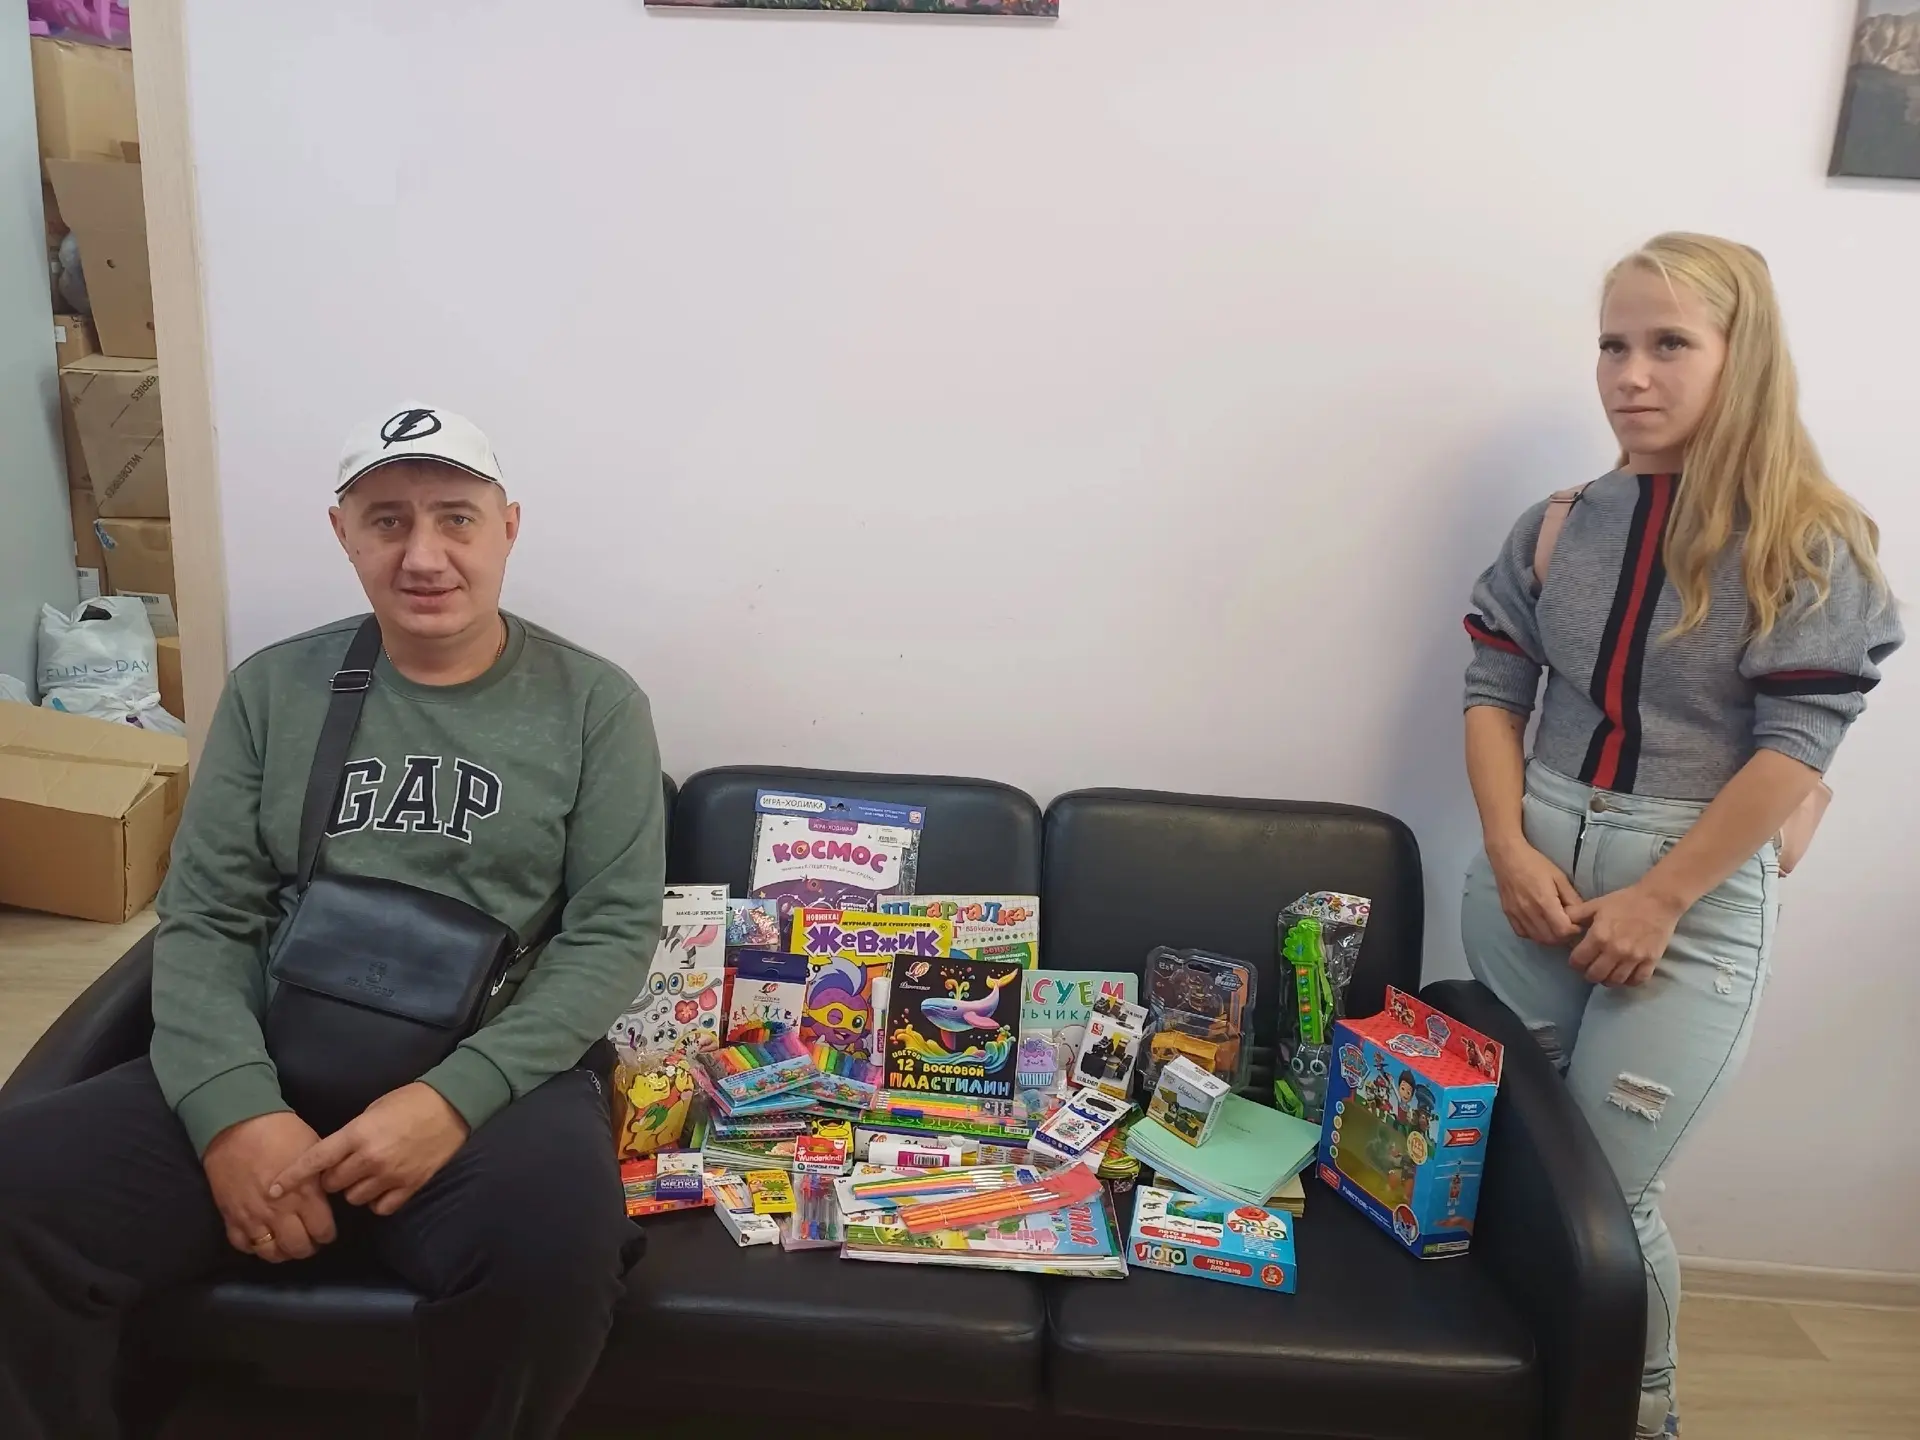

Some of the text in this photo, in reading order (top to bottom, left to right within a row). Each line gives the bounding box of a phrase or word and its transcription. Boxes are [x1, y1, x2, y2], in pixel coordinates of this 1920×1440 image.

[115, 659, 150, 674] DAY
[325, 755, 502, 845] GAP
[762, 796, 824, 811] ИГРА-ХОДИЛКА
[772, 840, 888, 874] КОСМОС
[805, 912, 840, 922] НОВИНКА!
[892, 1049, 922, 1060] ЦВЕТОВ
[897, 1058, 985, 1078] 12 ВОСКОВОЙ
[889, 1072, 1011, 1097] ПЛАСТИЛИН
[1232, 1222, 1286, 1239] ЛОТО
[1138, 1243, 1185, 1264] ЛОТО
[1206, 1258, 1224, 1266] лето
